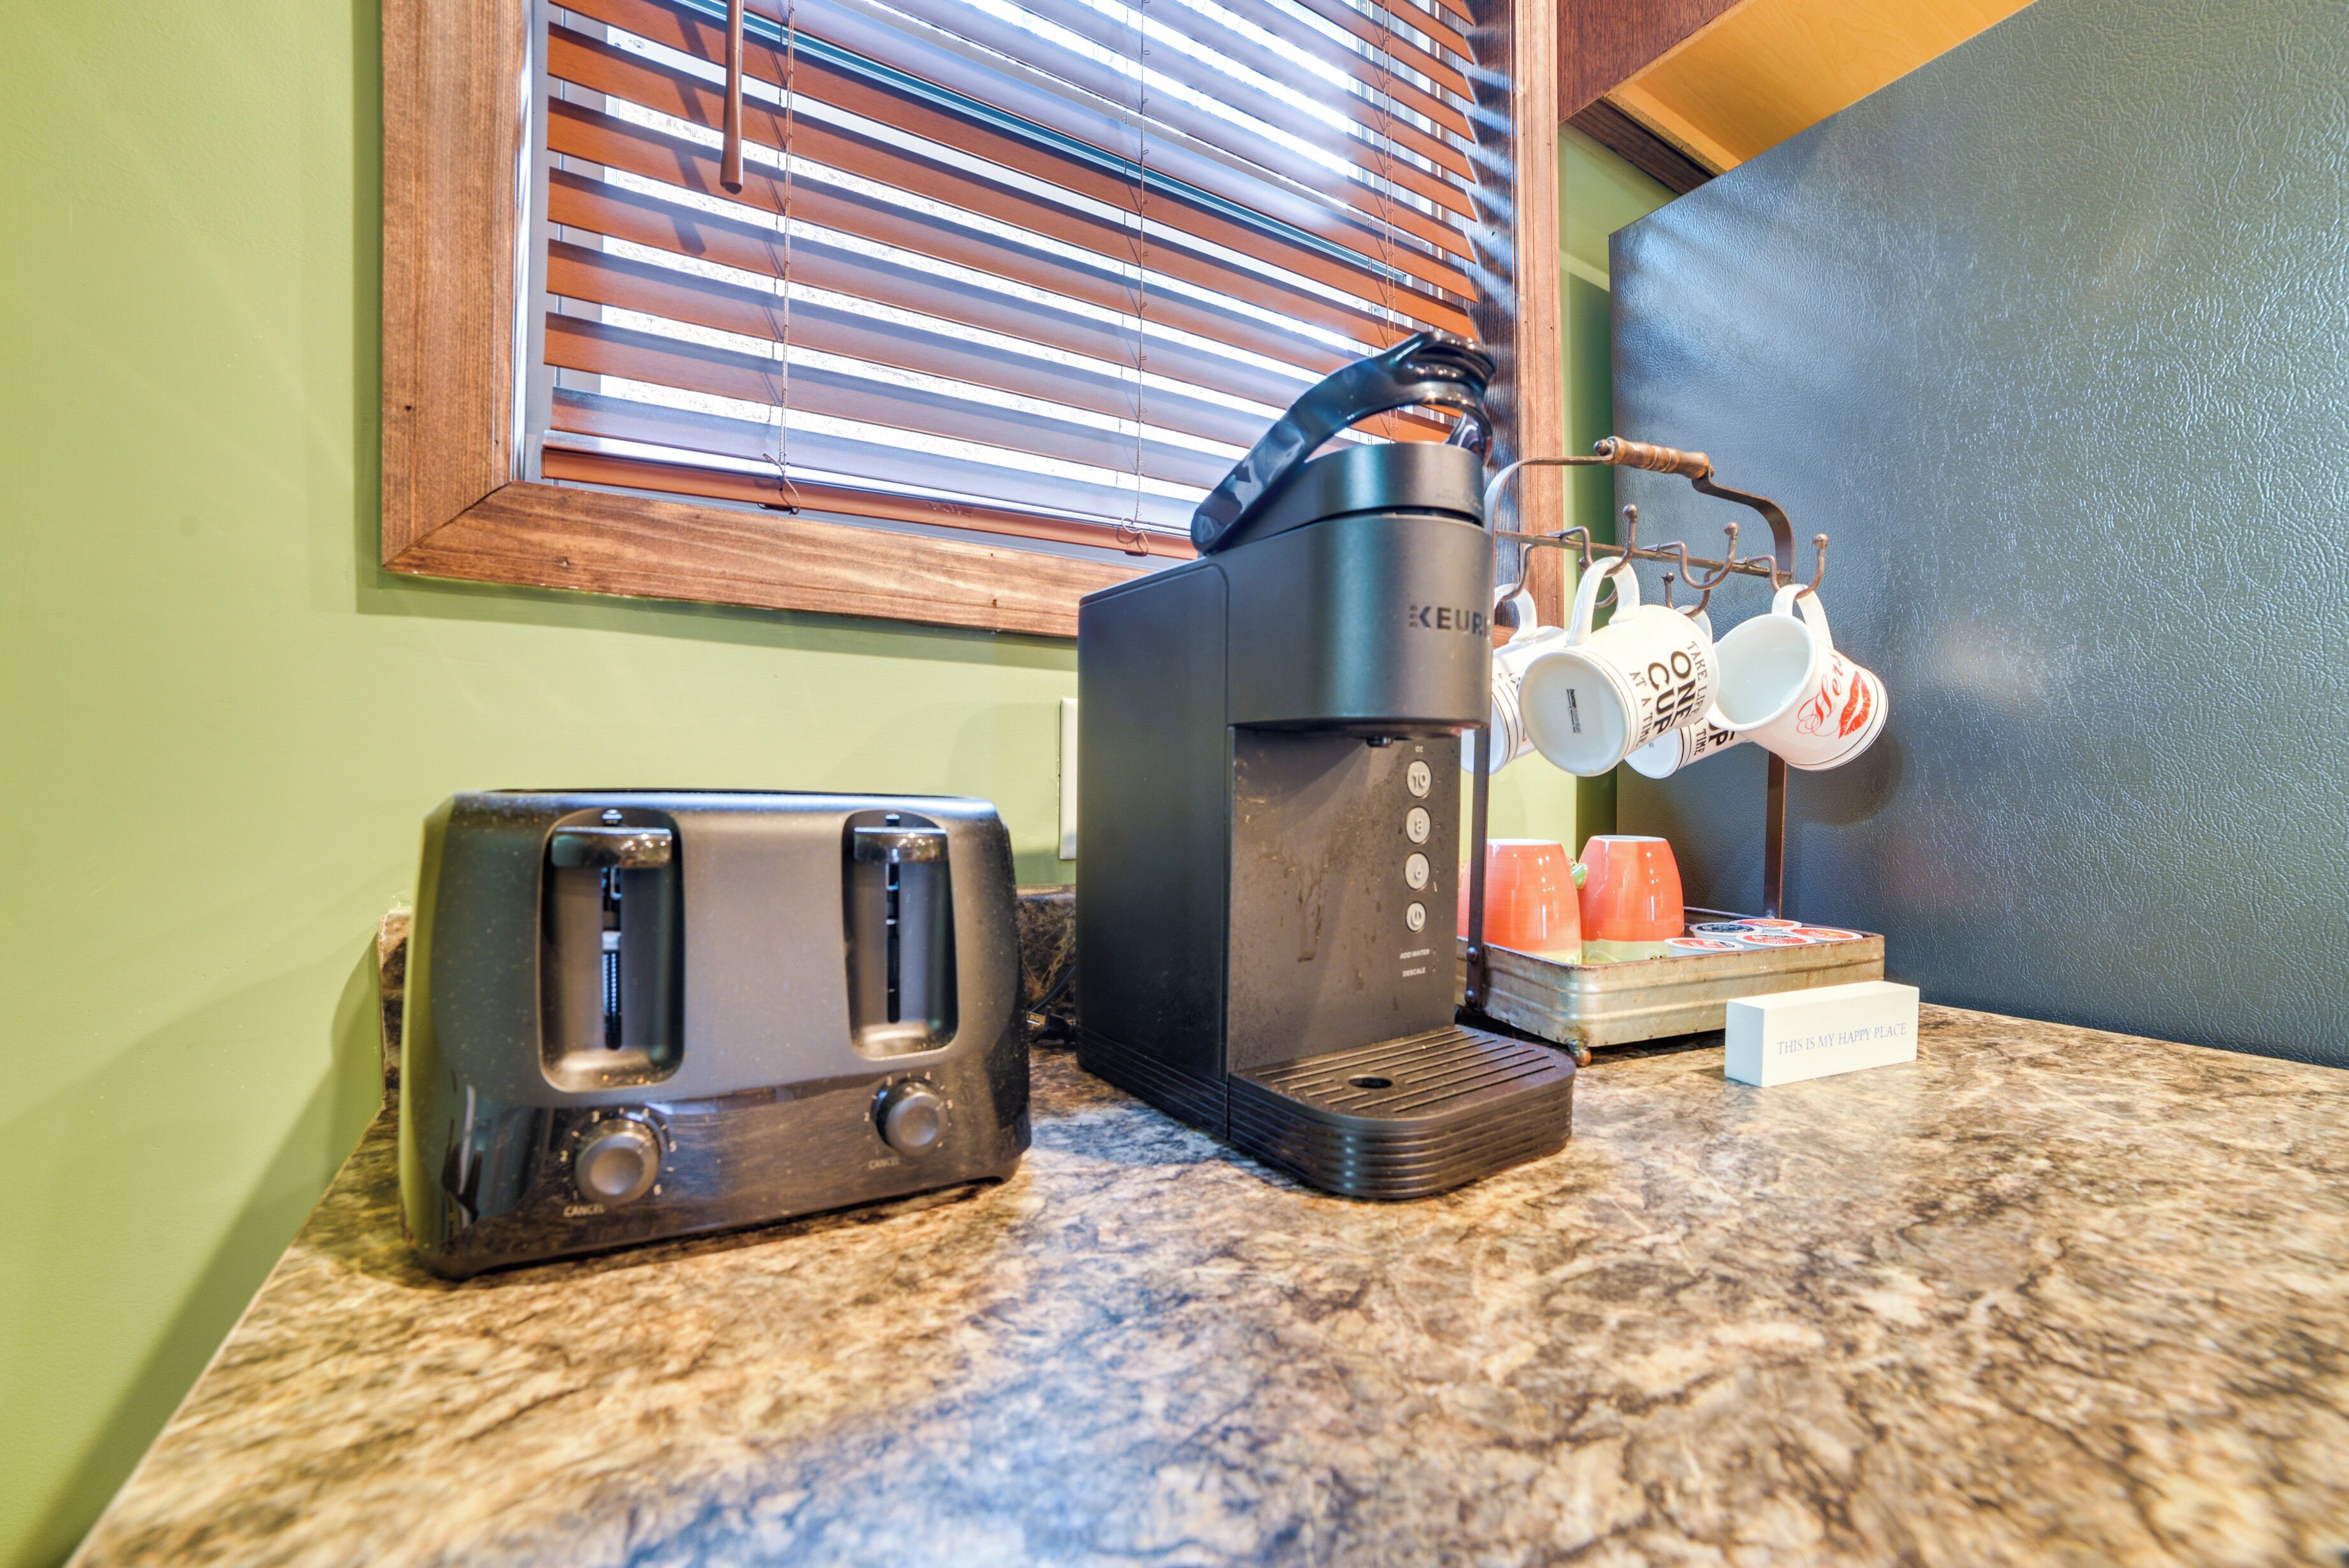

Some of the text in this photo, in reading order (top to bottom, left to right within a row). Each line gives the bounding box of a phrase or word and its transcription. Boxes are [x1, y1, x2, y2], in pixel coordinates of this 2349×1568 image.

[1409, 605, 1491, 638] KEURI
[1687, 641, 1708, 681] TAKE
[1648, 662, 1675, 734] CUP
[1670, 650, 1696, 727] ONE
[1629, 671, 1653, 747] AT A TIME
[1694, 729, 1707, 756] TIME
[1413, 771, 1426, 788] 10
[1414, 818, 1423, 835] 8
[1414, 862, 1423, 880] 6
[1399, 948, 1430, 959] ADD WATER
[1402, 966, 1426, 977] DESCALE
[1777, 1022, 1907, 1055] THIS IS MY HAPPY PLACE
